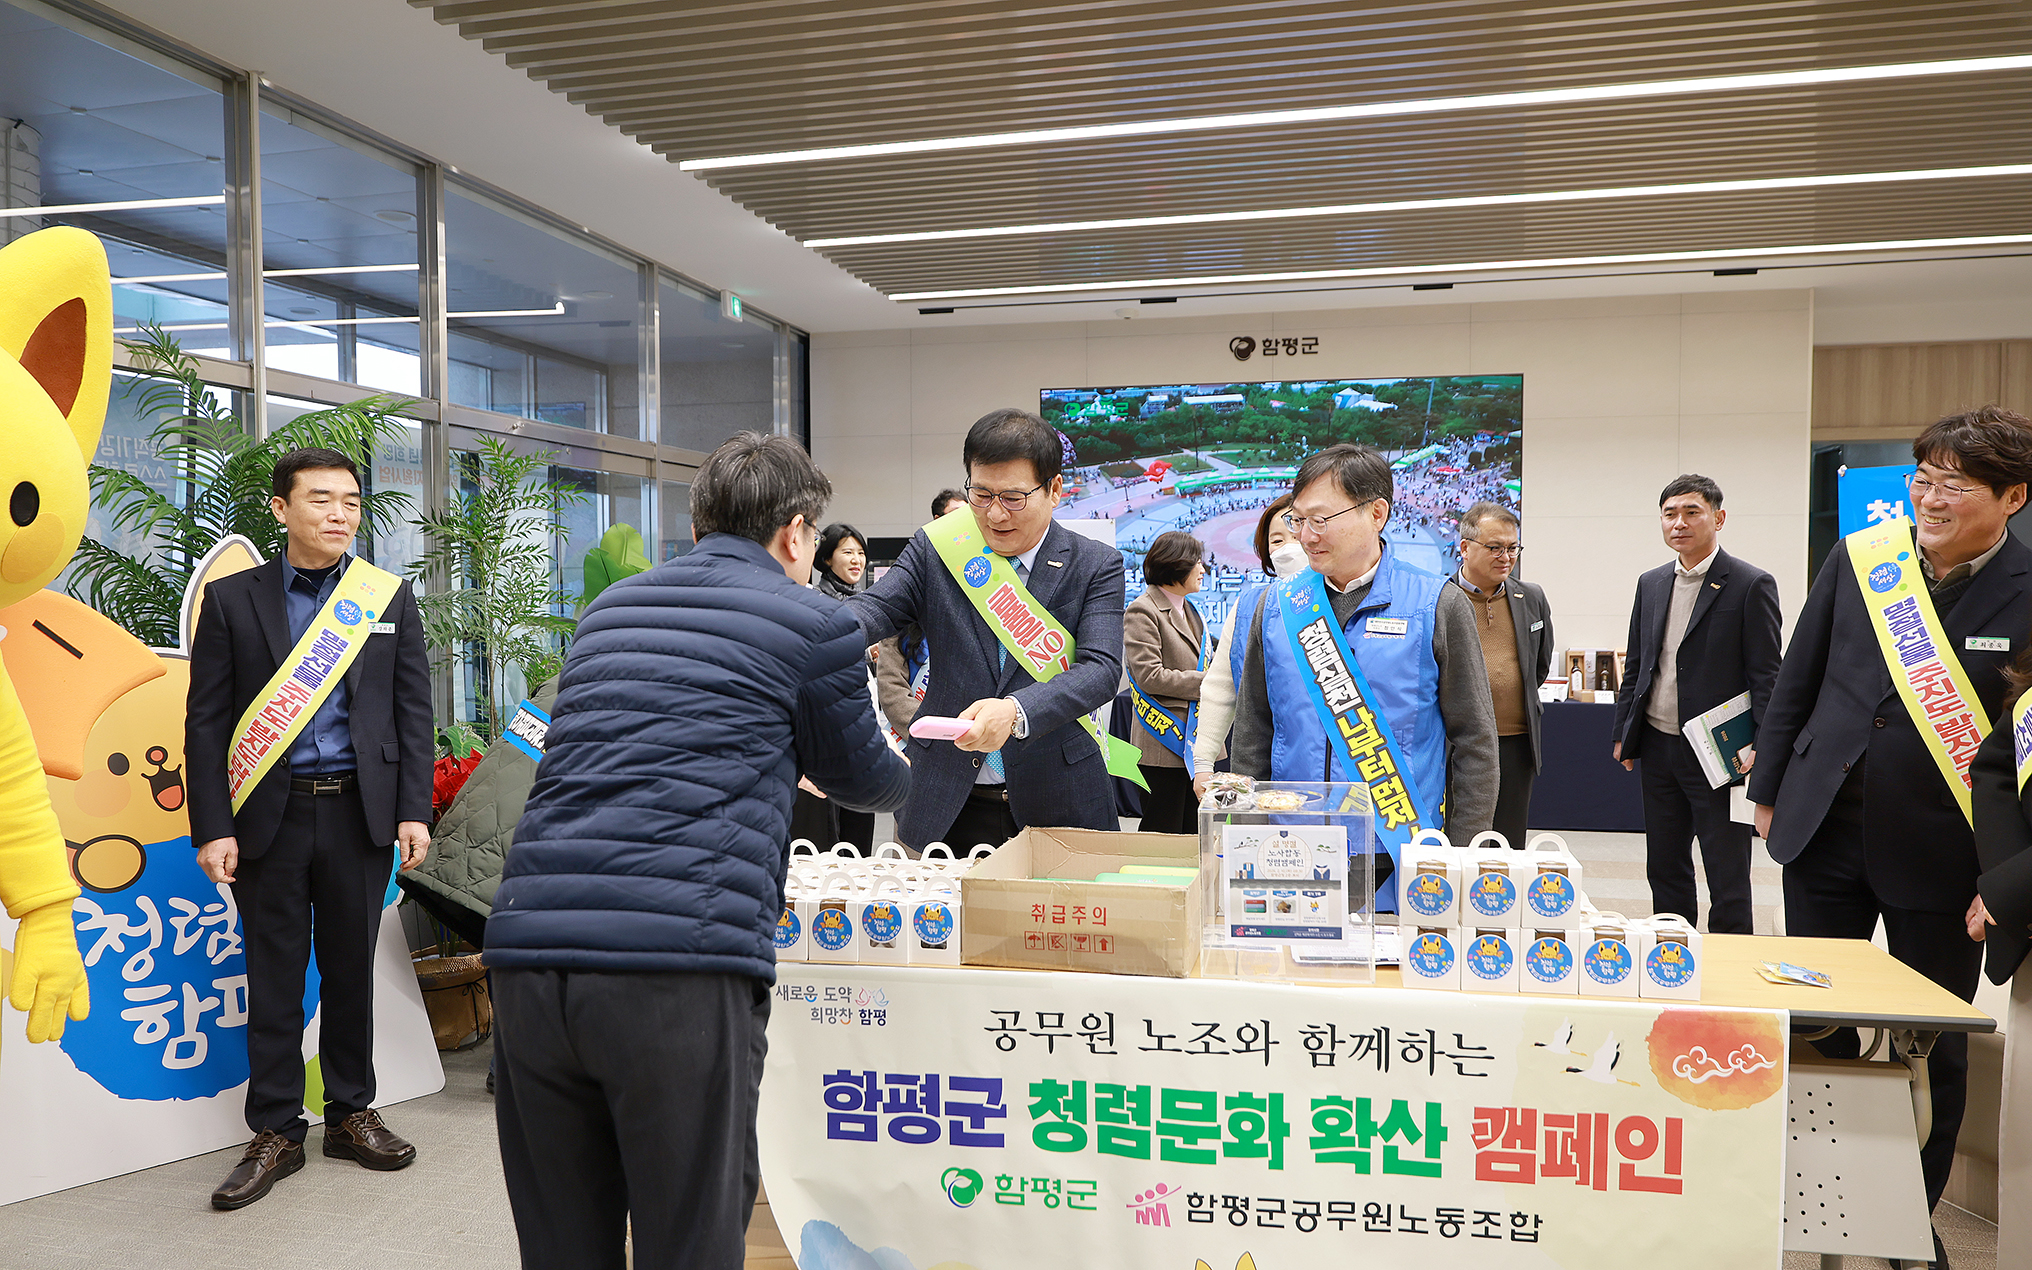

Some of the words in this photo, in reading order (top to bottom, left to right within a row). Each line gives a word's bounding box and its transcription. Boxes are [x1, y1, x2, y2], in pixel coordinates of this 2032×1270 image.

[1262, 337, 1319, 356] 함평군
[1883, 596, 1936, 667] 명절선물
[292, 628, 349, 690] 명절선물
[1299, 617, 1362, 715] 청렴실천
[259, 680, 312, 732] 주지도
[1908, 661, 1966, 720] 주지도
[235, 718, 281, 769] 받지도
[72, 882, 243, 982] 청렴
[1031, 903, 1108, 926] 취급주의
[776, 985, 818, 1003] 새로운
[824, 986, 852, 1003] 도약
[811, 1007, 853, 1025] 희망찬
[859, 1009, 887, 1026] 함평
[984, 1010, 1118, 1055] 공무원
[1138, 1018, 1280, 1067] 노조와
[1298, 1022, 1495, 1077] 함께하는
[822, 1069, 1008, 1149] 함평군
[1027, 1078, 1290, 1171] 청렴문화
[1309, 1095, 1448, 1179] 확산
[1471, 1106, 1684, 1195] 캠페인
[994, 1173, 1098, 1211] 함평군
[1186, 1192, 1543, 1243] 함평군공무원노동조합
